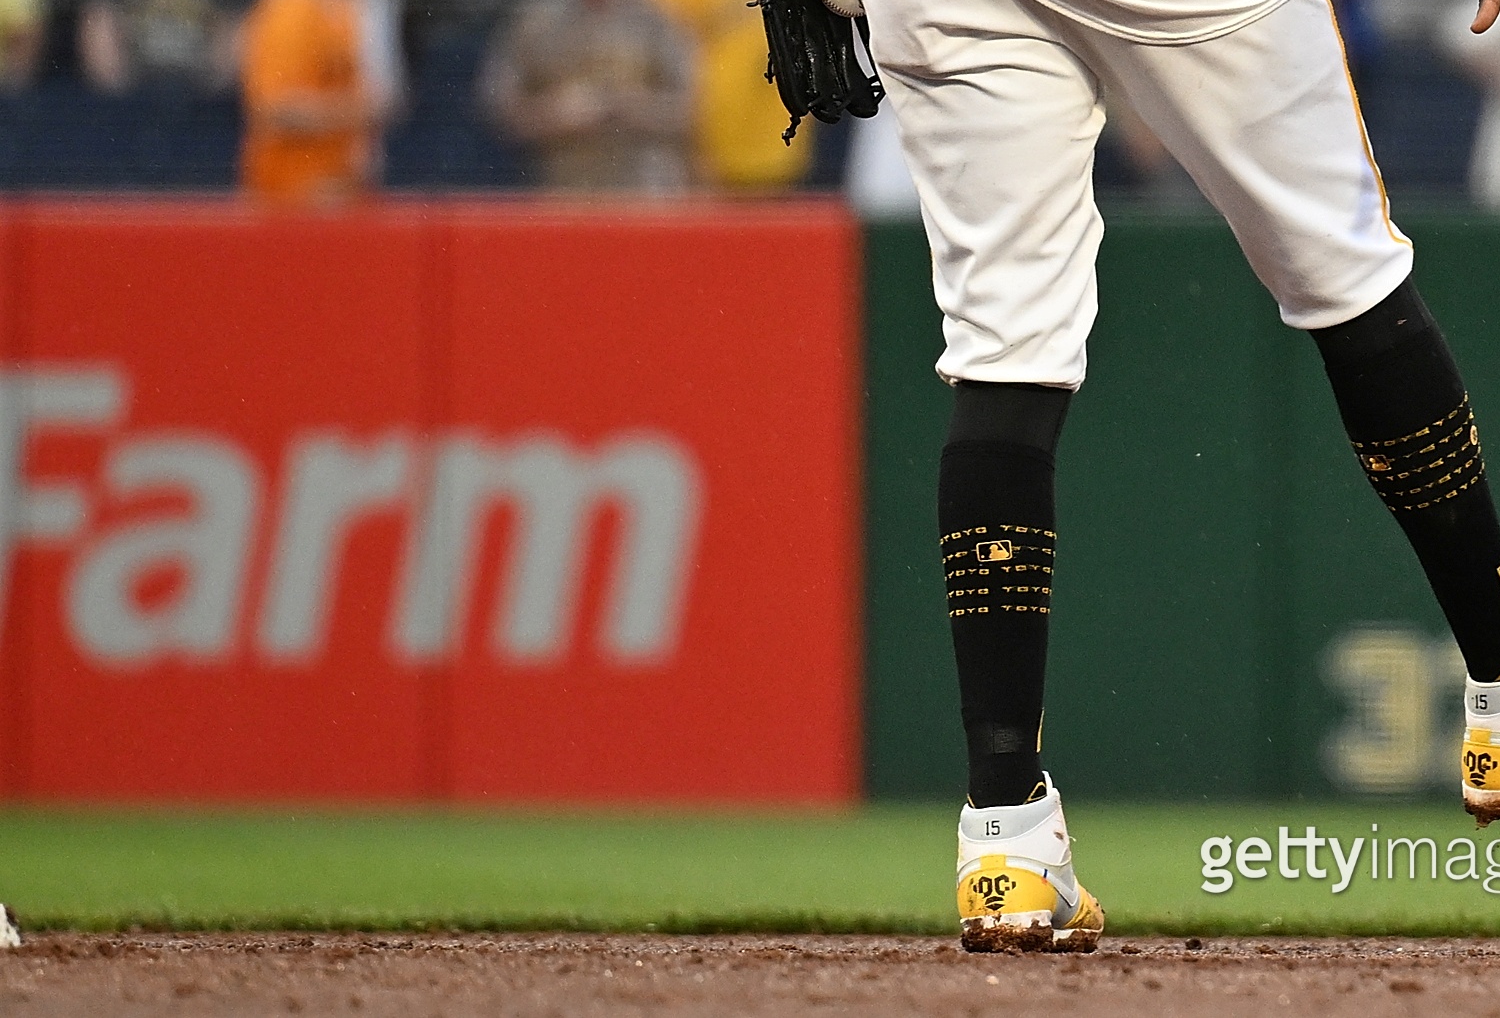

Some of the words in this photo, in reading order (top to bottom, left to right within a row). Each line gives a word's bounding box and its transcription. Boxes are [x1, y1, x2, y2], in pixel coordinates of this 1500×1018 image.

[0, 360, 692, 668] Farm
[1474, 693, 1488, 710] 15
[985, 820, 1001, 836] 15
